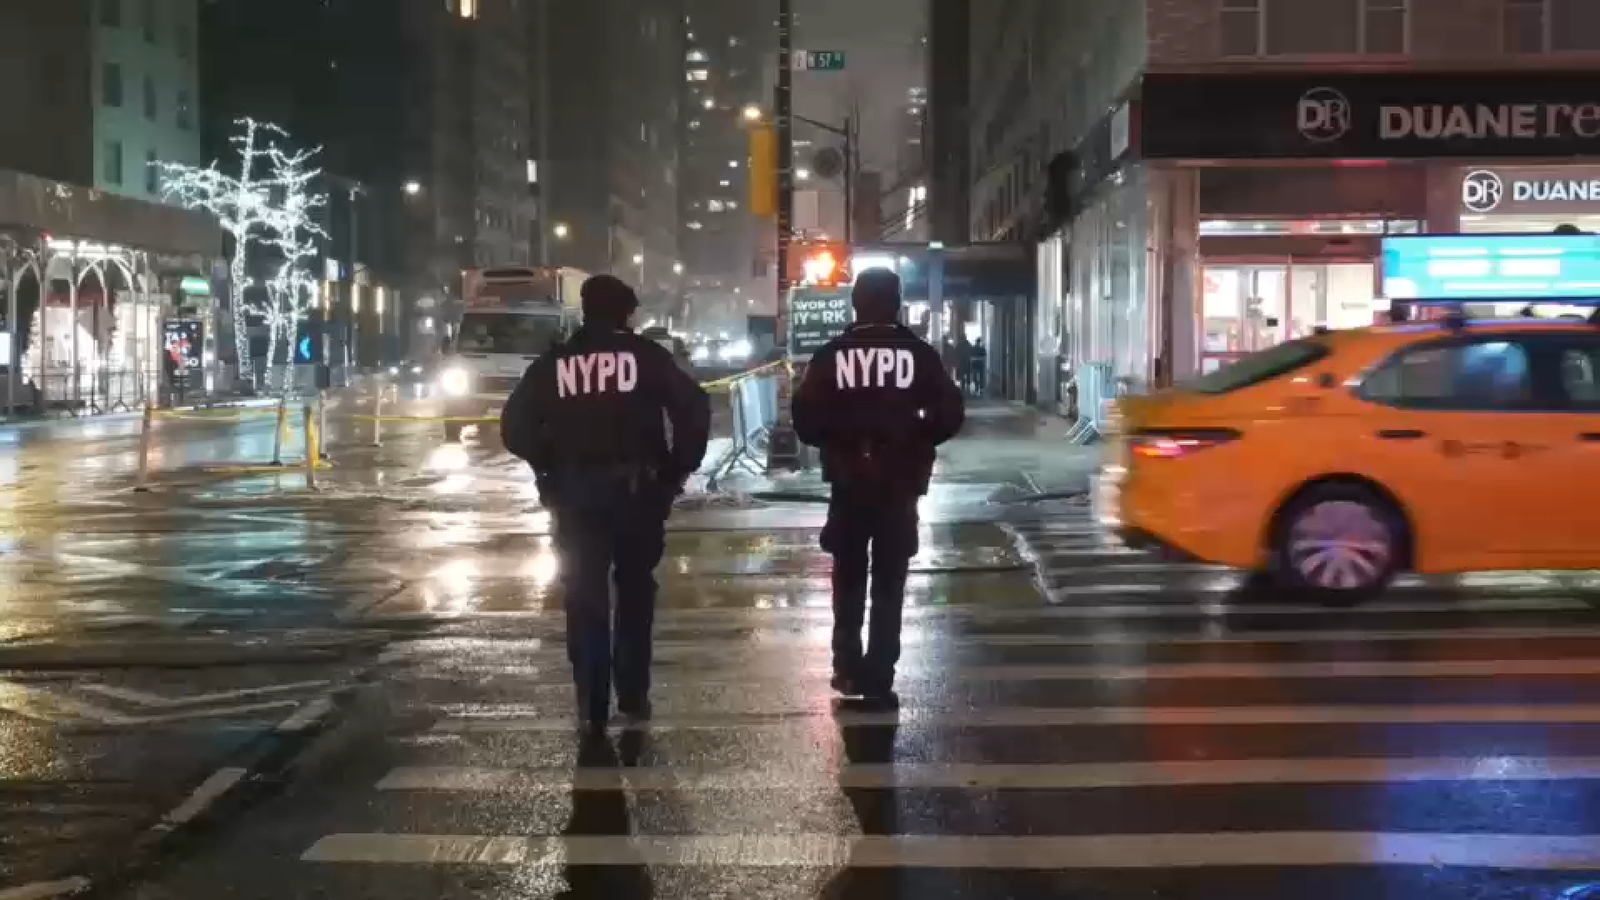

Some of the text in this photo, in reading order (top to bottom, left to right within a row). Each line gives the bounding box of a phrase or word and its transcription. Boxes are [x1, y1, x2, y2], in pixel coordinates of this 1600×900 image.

[1379, 104, 1537, 139] DUANE
[1463, 180, 1600, 204] DR DUANE
[829, 300, 846, 310] OF
[556, 352, 637, 398] NYPD
[835, 347, 914, 389] NYPD
